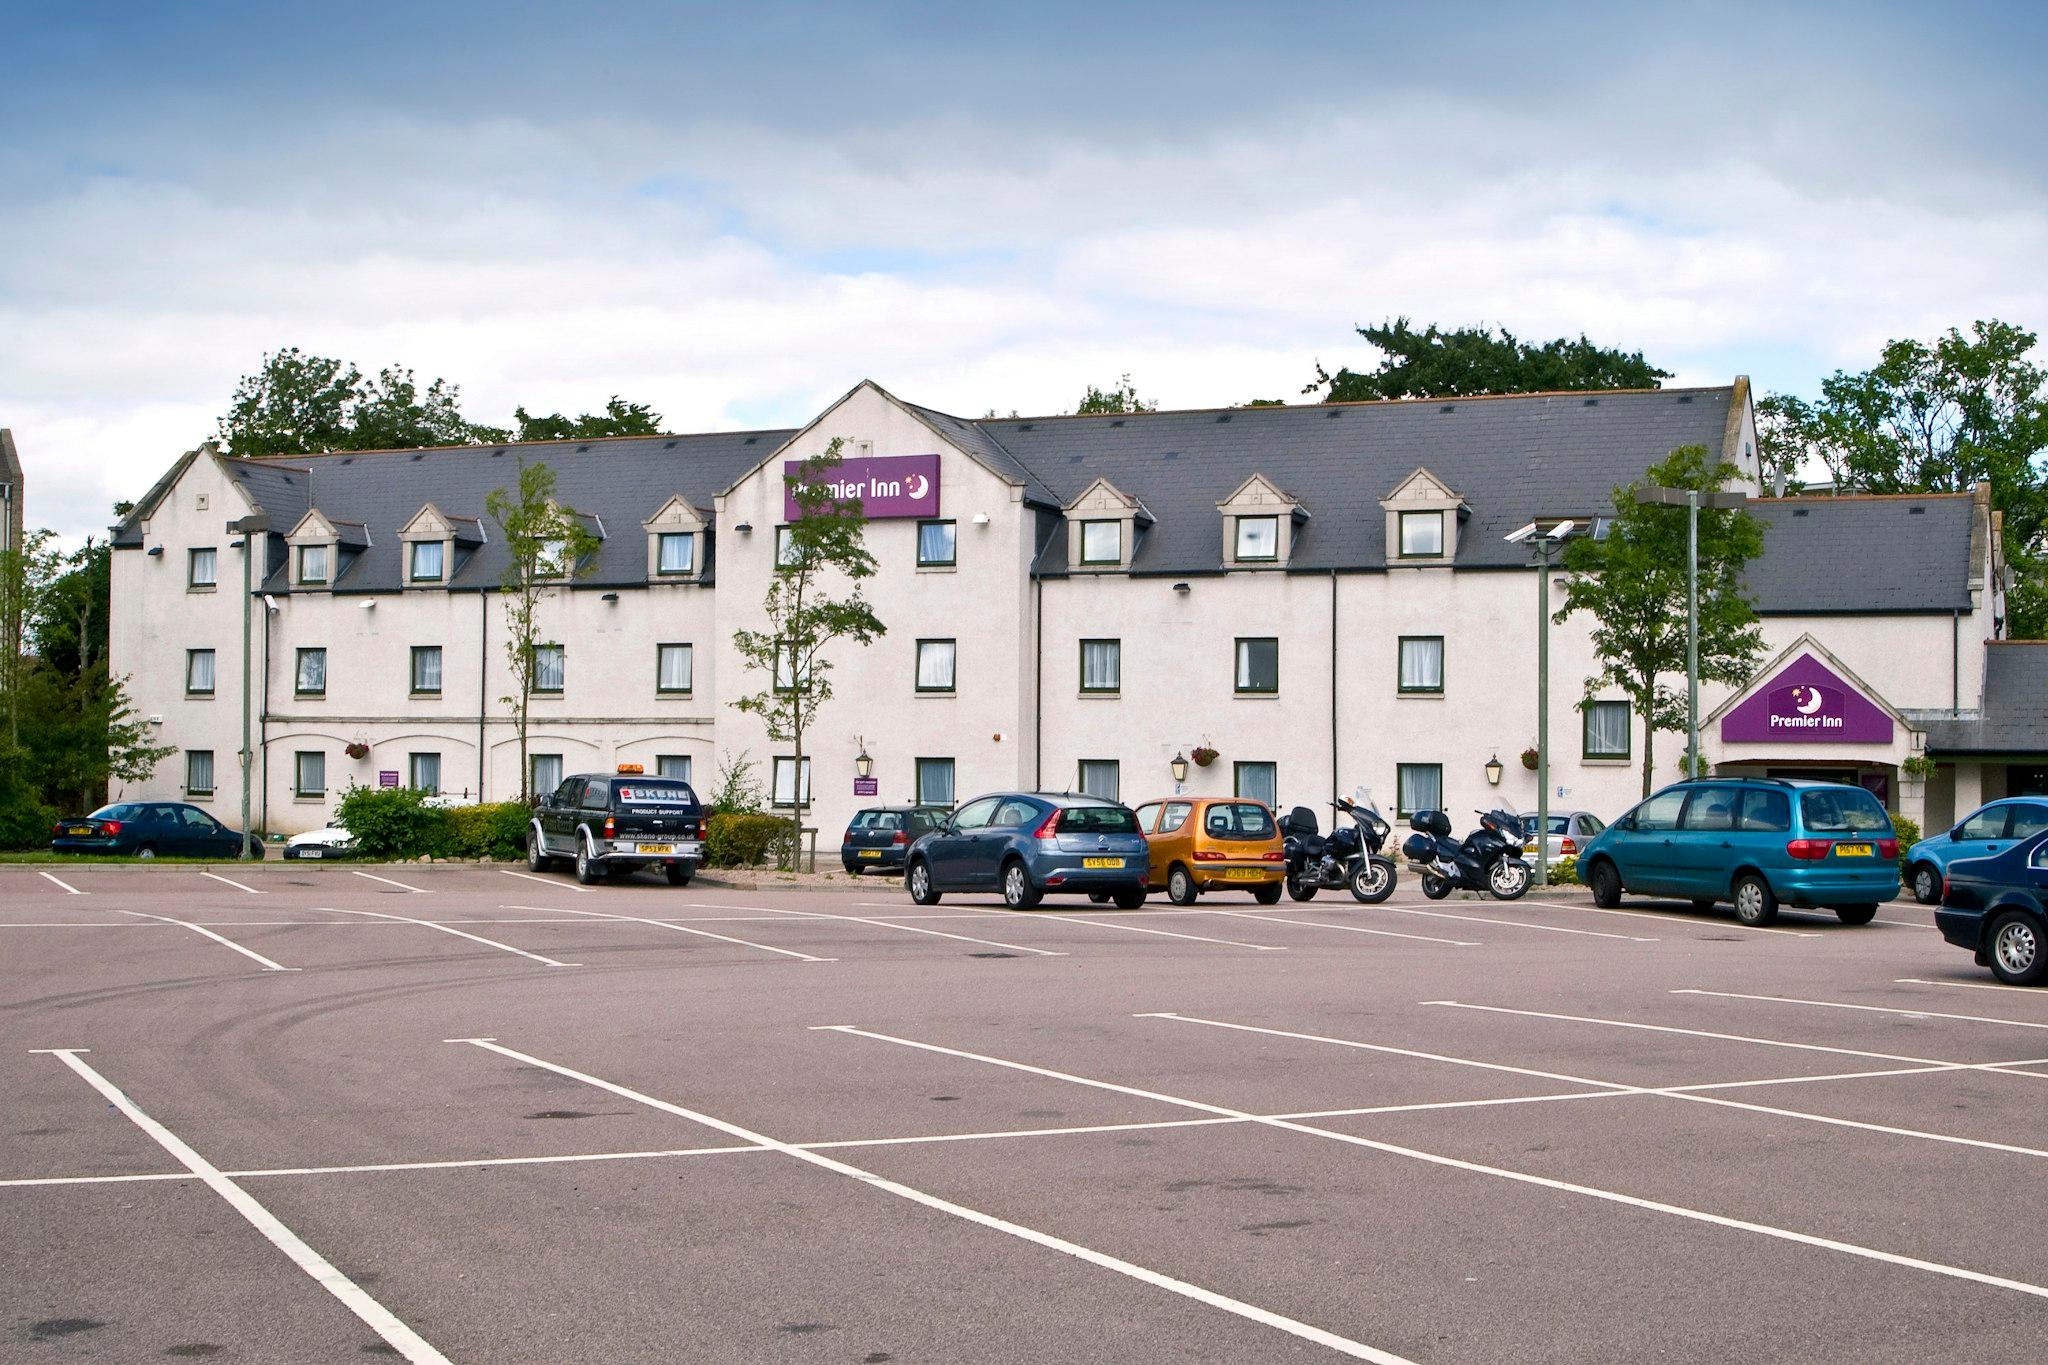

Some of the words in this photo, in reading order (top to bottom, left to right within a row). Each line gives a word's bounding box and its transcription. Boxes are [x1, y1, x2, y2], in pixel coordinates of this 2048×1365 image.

[871, 477, 900, 498] Inn
[1770, 714, 1821, 728] Premier
[1822, 714, 1843, 728] Inn
[635, 789, 688, 799] SKENE
